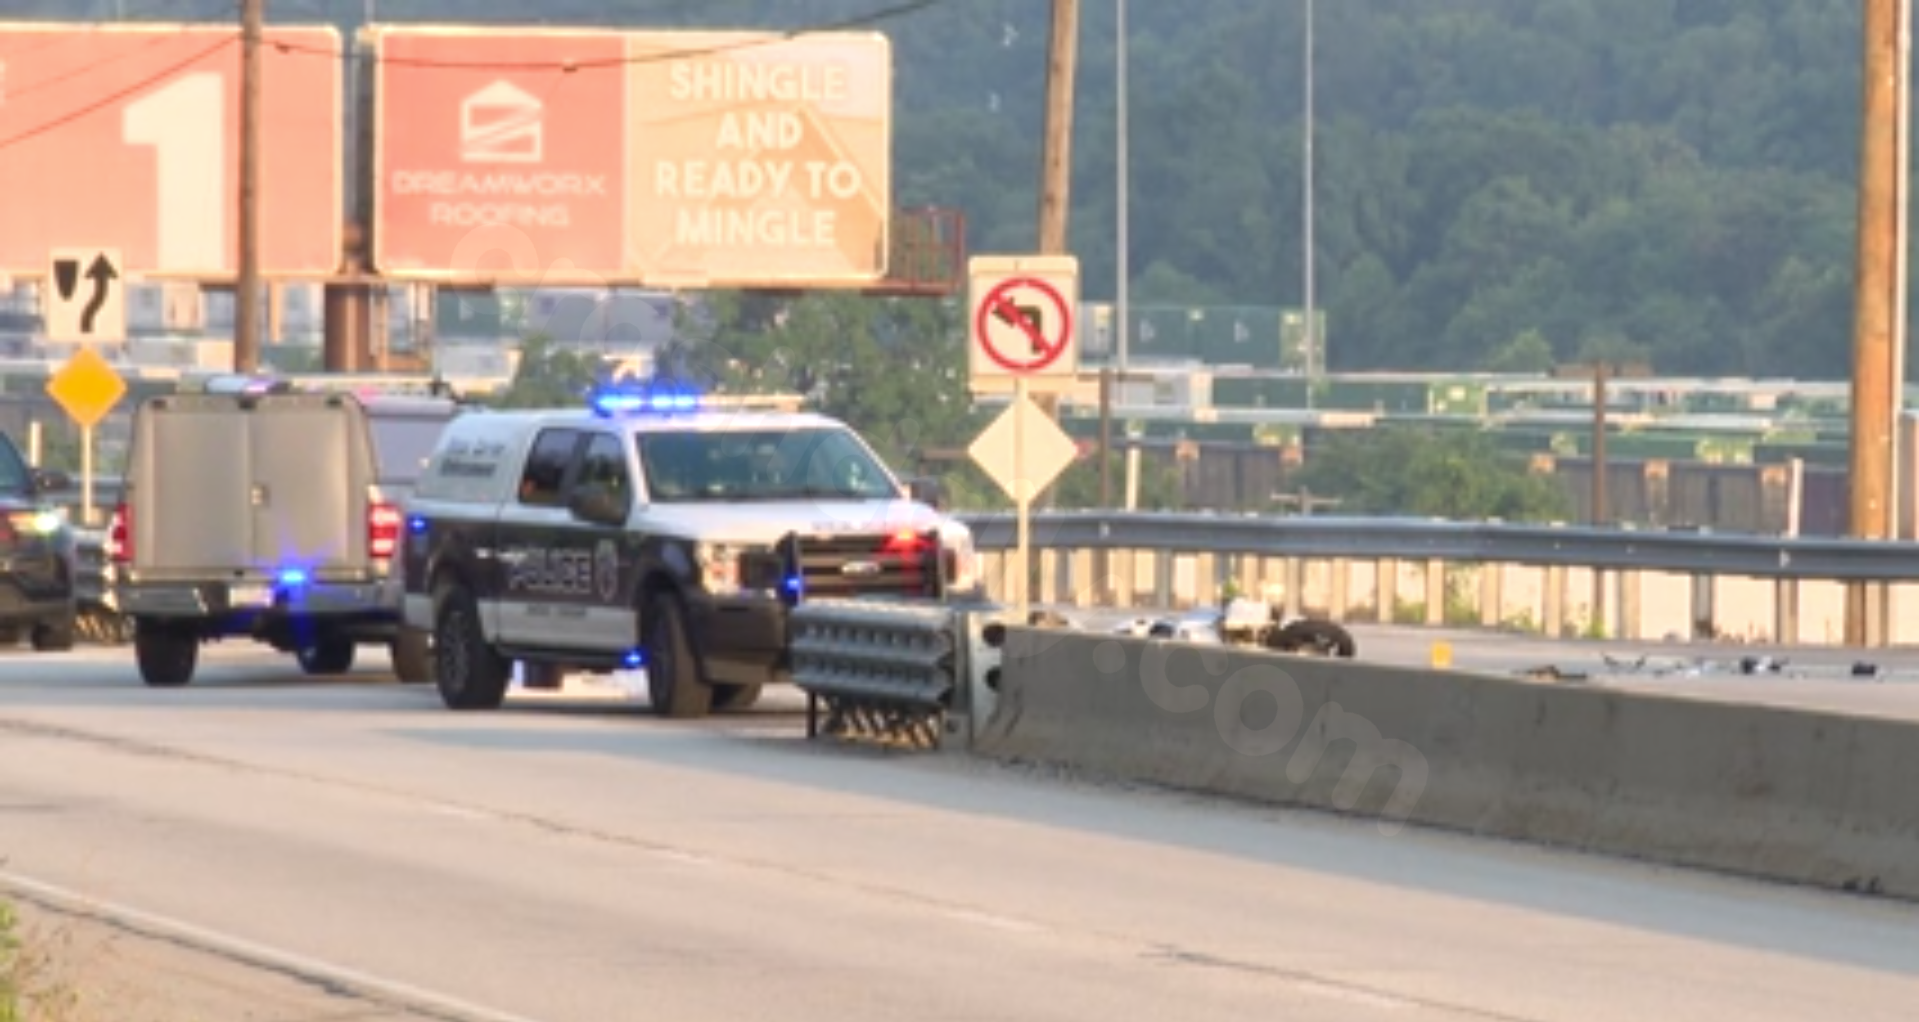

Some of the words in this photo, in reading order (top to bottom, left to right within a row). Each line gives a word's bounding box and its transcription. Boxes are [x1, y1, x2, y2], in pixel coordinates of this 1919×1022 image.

[670, 65, 846, 102] SHINGLE
[716, 112, 803, 150] AND
[122, 71, 224, 271] 1
[392, 170, 606, 196] DREAMWORX
[655, 161, 790, 198] READY
[805, 161, 861, 199] TO
[430, 204, 571, 228] ROOFING
[676, 210, 837, 246] MINGLE
